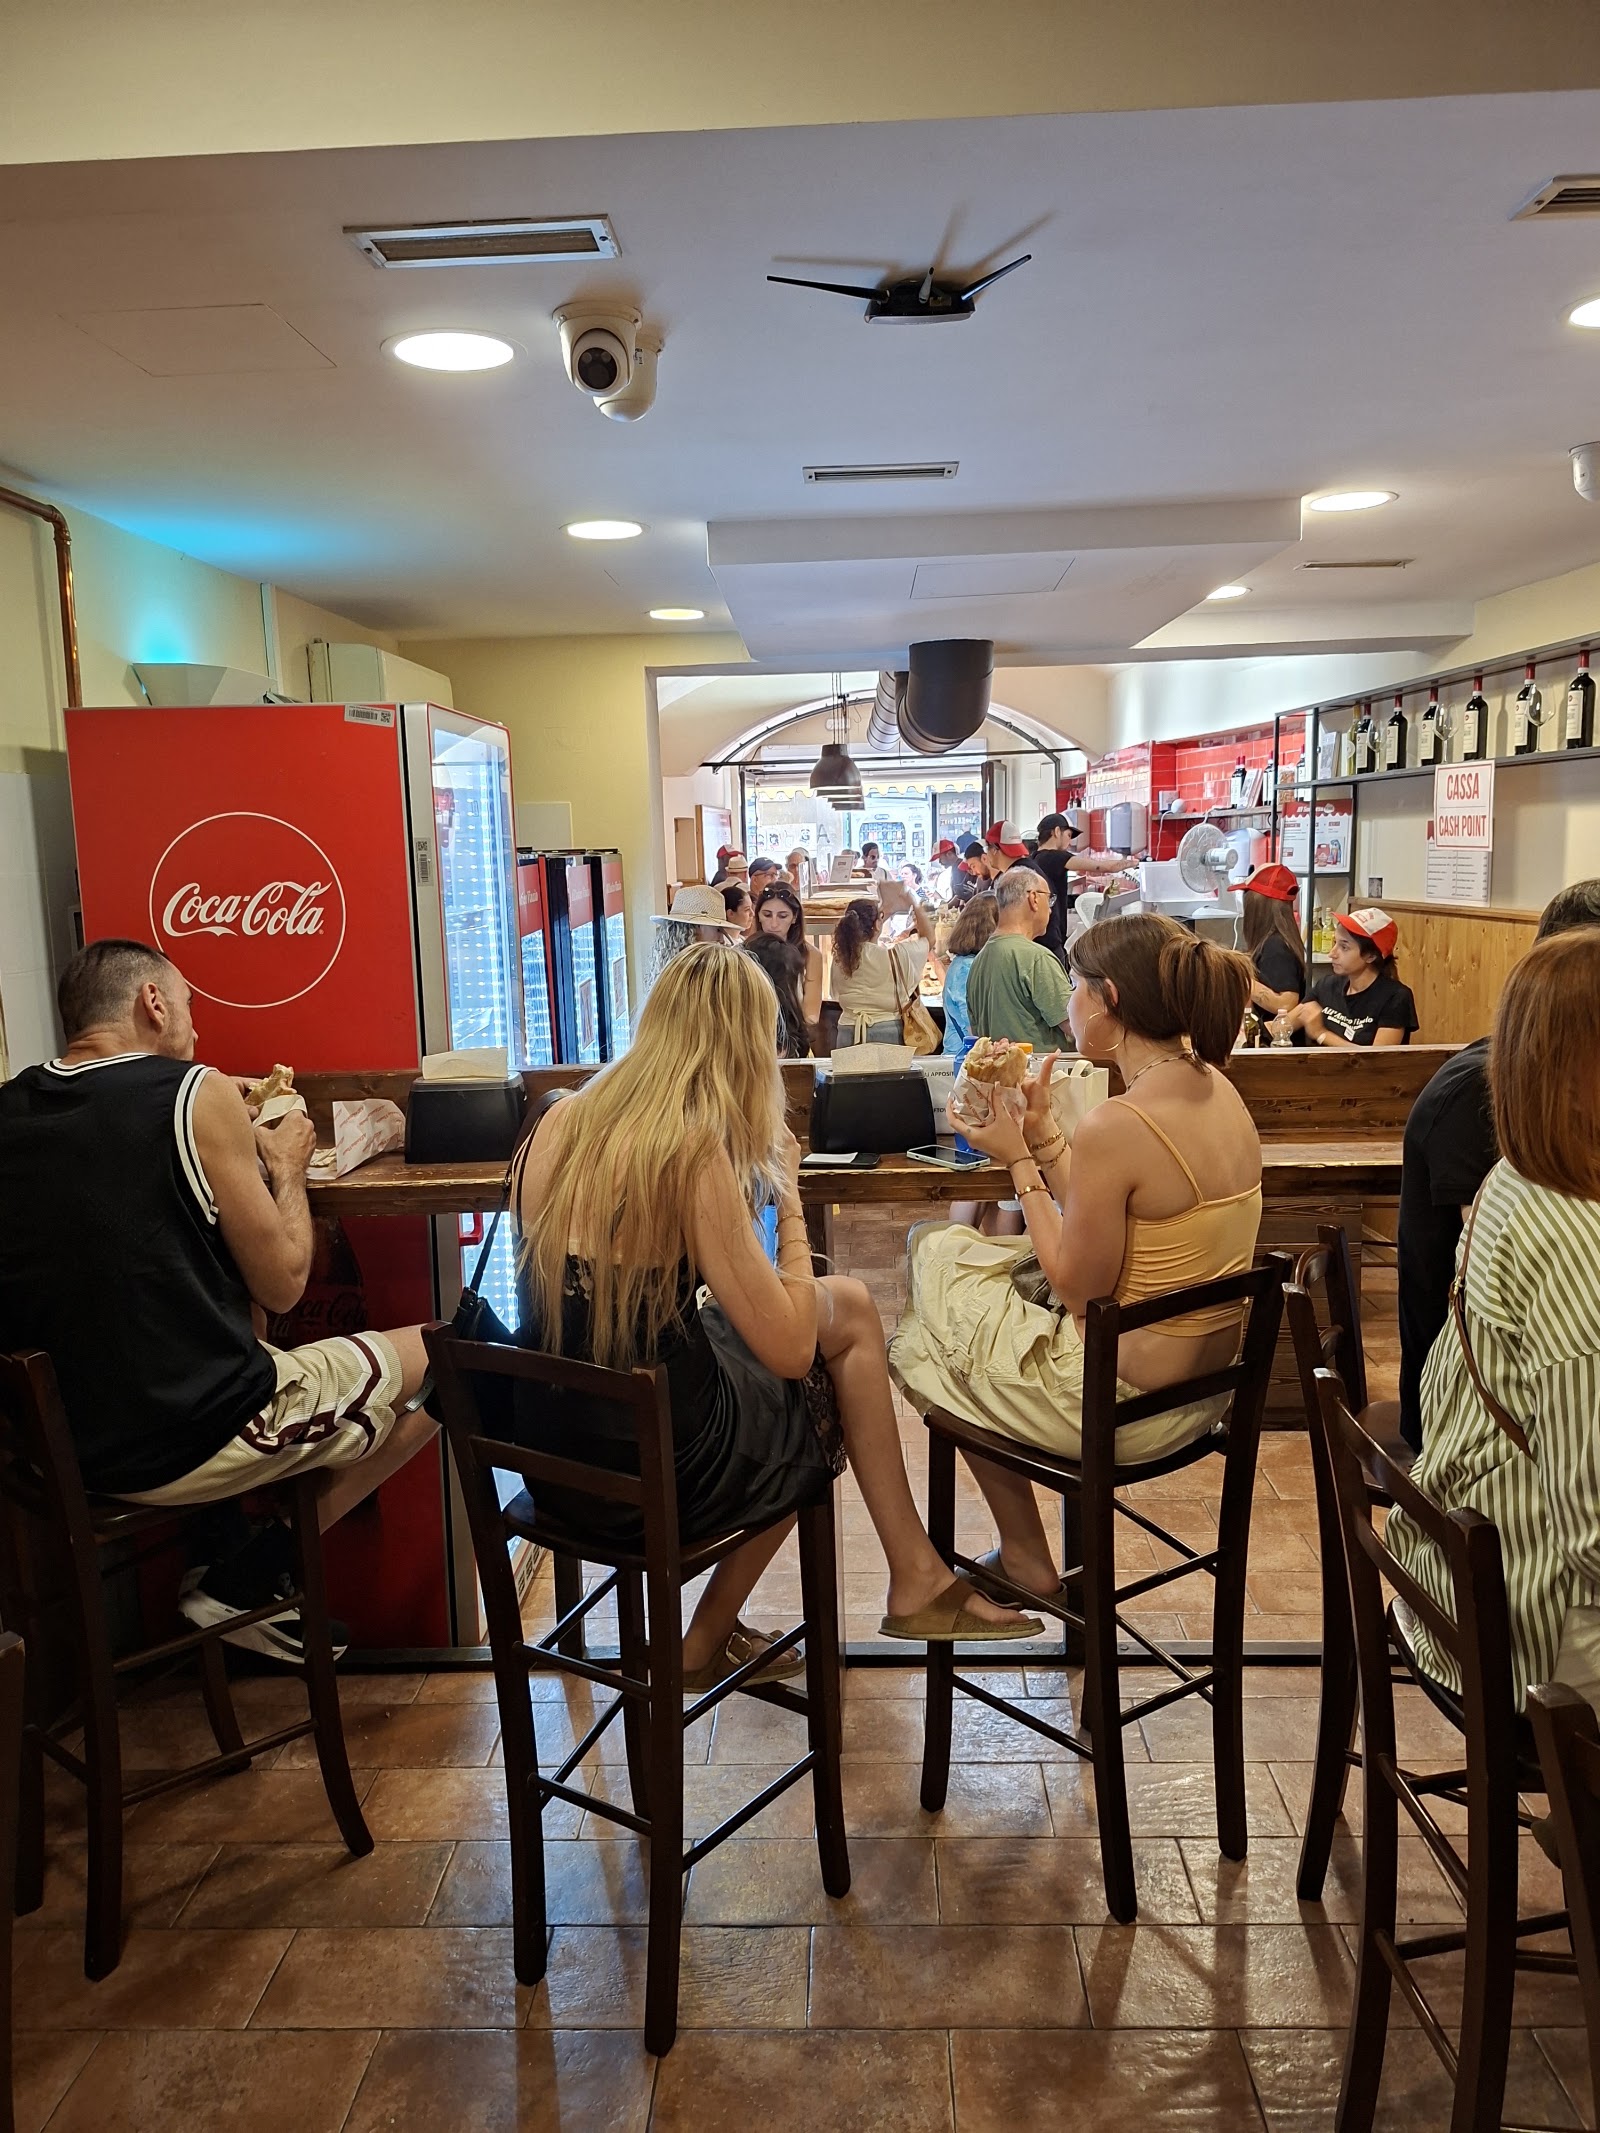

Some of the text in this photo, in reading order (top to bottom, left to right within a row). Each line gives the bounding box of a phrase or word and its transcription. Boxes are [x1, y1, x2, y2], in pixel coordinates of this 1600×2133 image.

[1446, 772, 1480, 801] CASSA
[1439, 815, 1487, 837] CASH POINT
[162, 881, 334, 938] Coca-Cola
